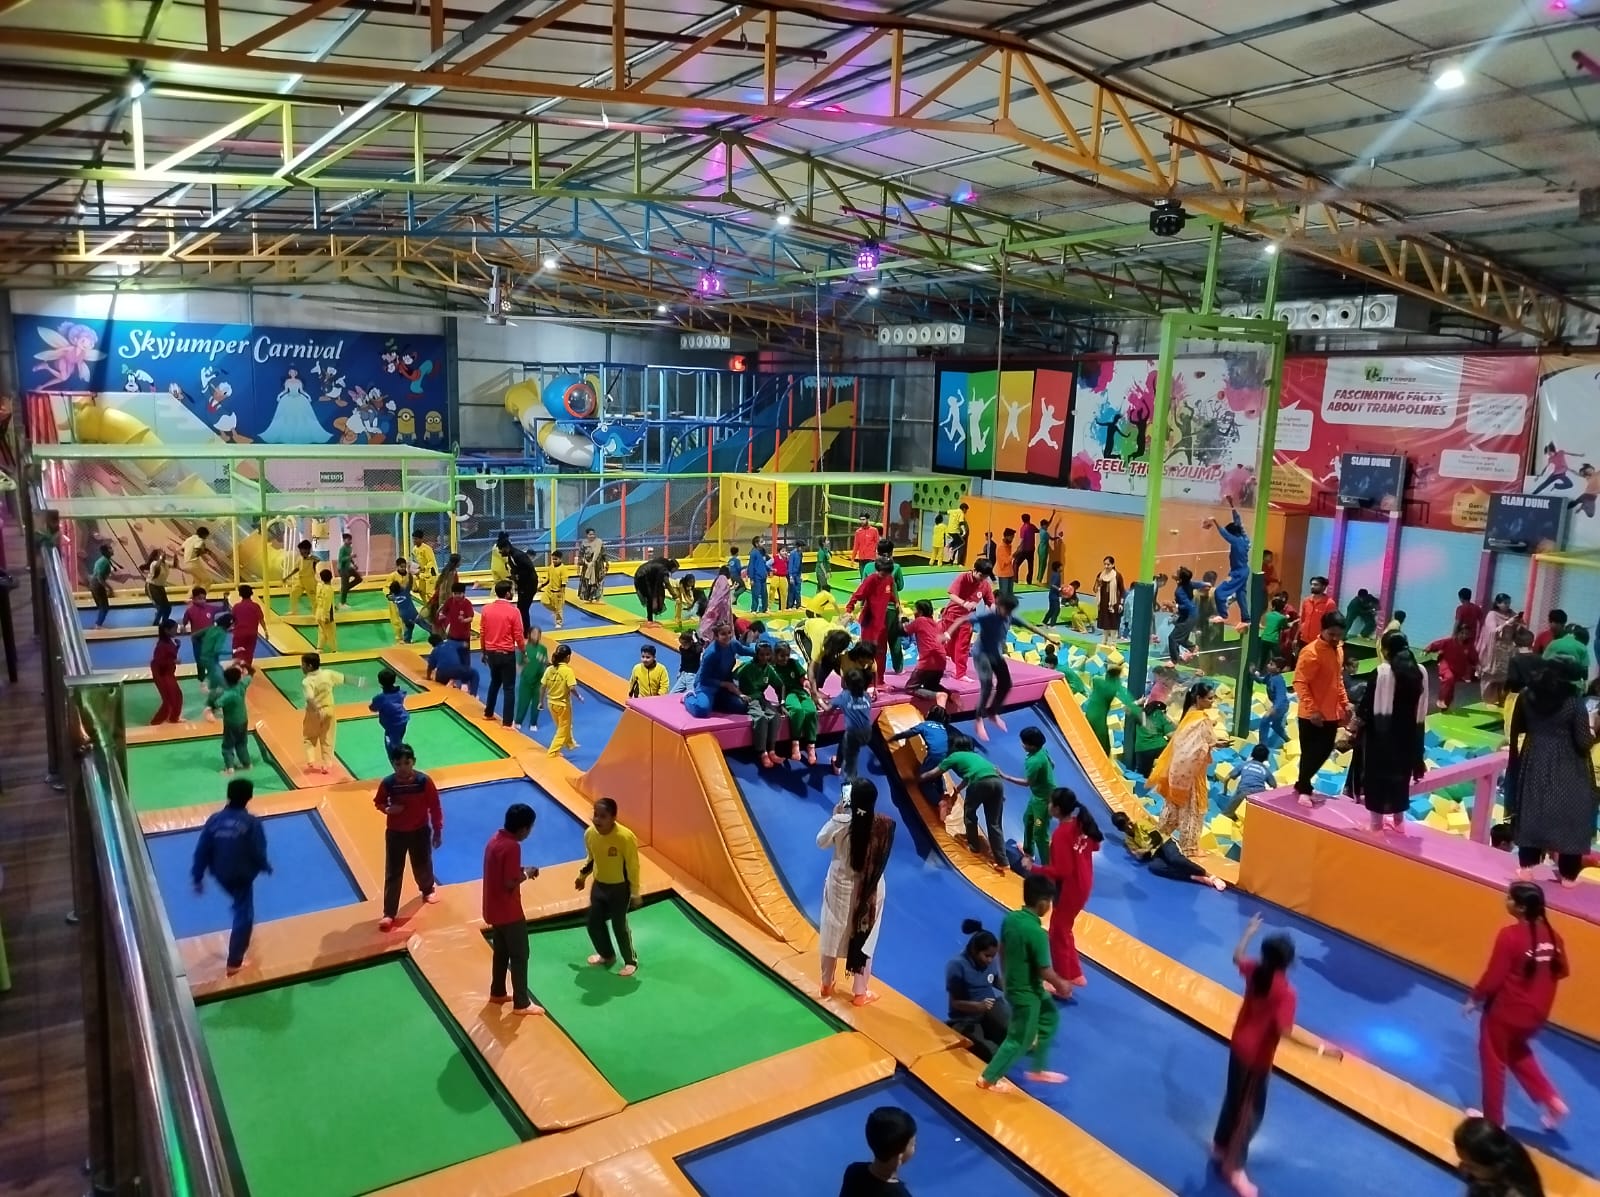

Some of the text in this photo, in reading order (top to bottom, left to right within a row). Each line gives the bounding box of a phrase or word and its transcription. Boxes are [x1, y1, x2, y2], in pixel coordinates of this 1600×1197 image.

[118, 329, 344, 363] Skyjumper Carnival
[1334, 389, 1405, 401] FASCINATING
[1327, 401, 1449, 416] ABOUT TRAMPOLINES
[1094, 459, 1125, 473] FEEL
[1130, 461, 1149, 476] TH
[1351, 456, 1391, 468] SLAM DUNK
[1501, 496, 1550, 509] SLAM DUNK
